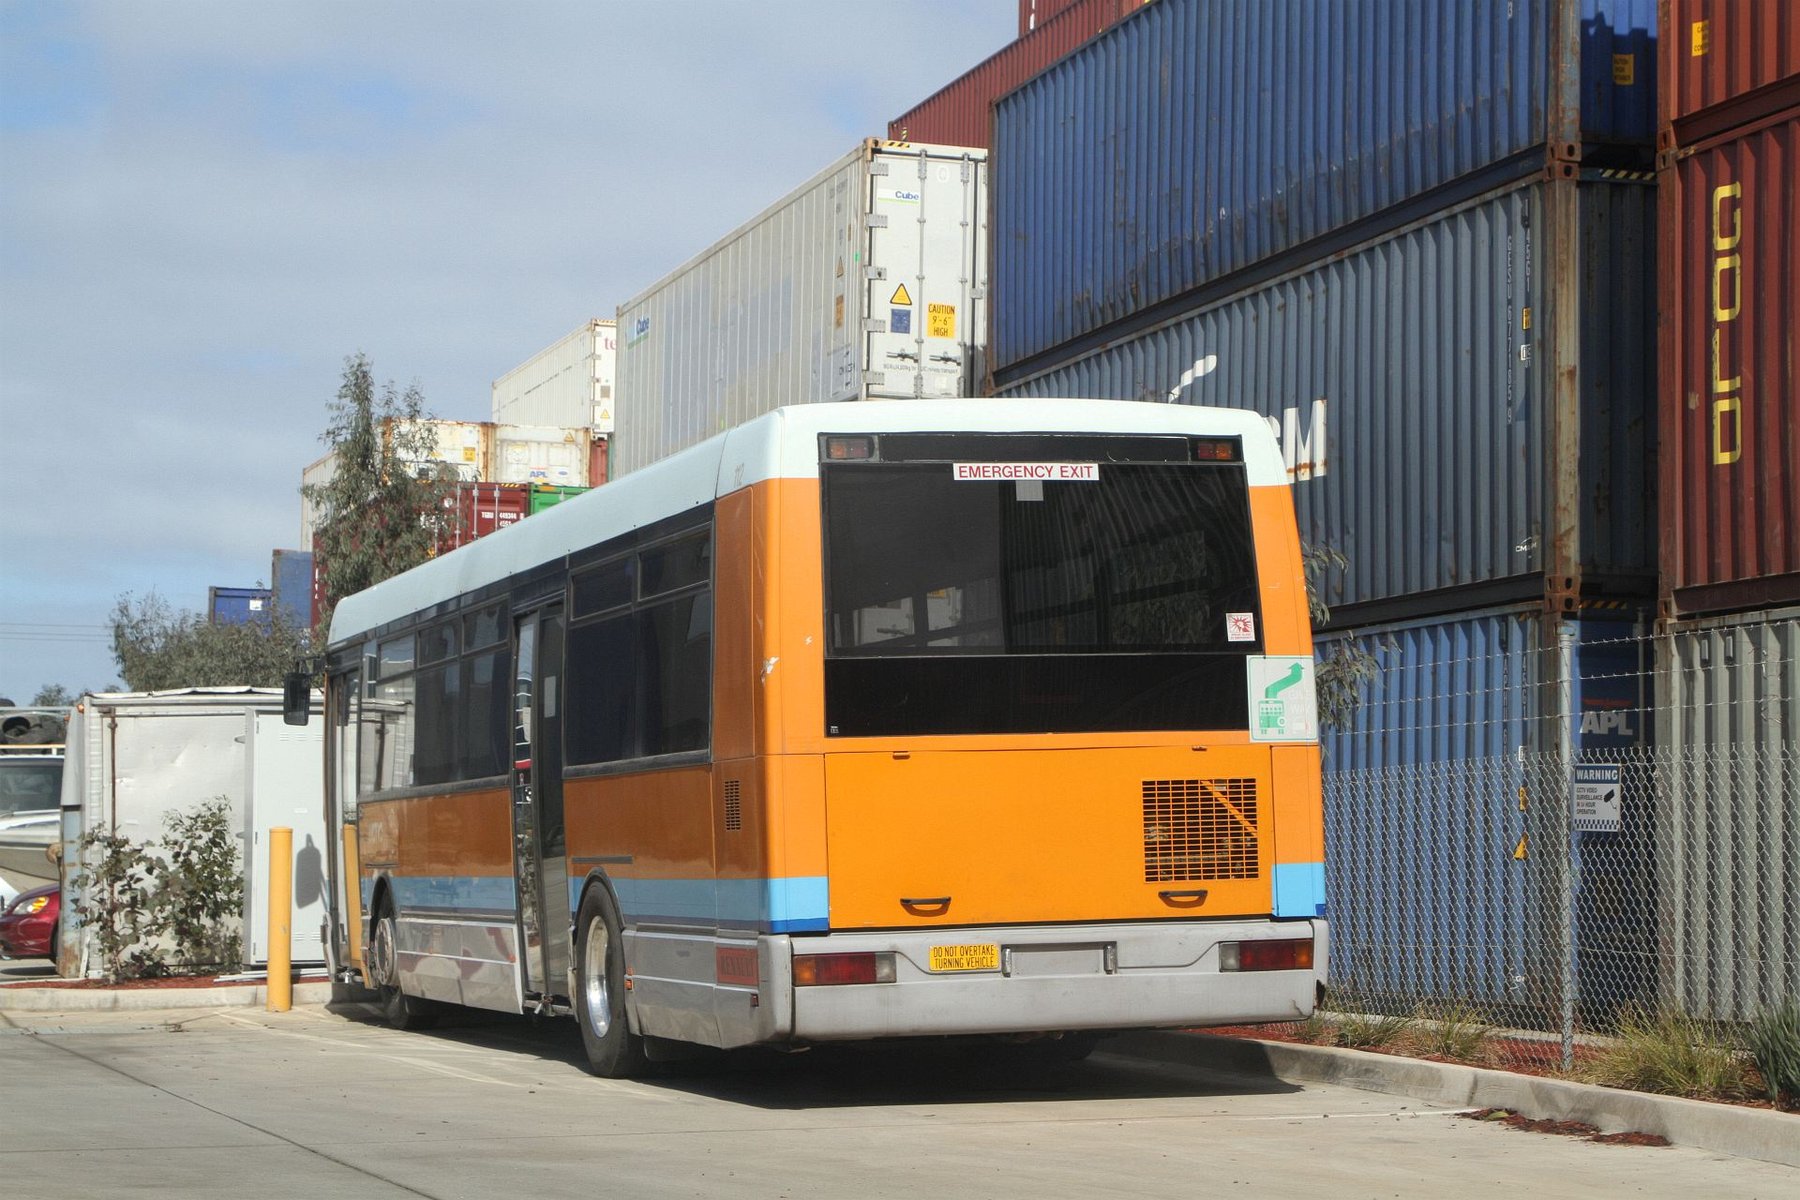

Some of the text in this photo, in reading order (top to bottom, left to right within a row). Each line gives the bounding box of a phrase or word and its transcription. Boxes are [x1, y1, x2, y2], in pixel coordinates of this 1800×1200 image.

[895, 190, 920, 201] Cube
[928, 303, 955, 316] CAUTION
[636, 316, 650, 335] Cube
[1713, 181, 1741, 465] GOLD
[933, 326, 949, 337] HIGH
[529, 470, 549, 479] APL
[958, 465, 1094, 479] EMERGENCY EXIT
[1579, 710, 1633, 736] APL
[1576, 769, 1618, 781] WARNING
[933, 944, 995, 958] DO NOT OVERTAKE
[934, 955, 995, 970] TURNING VEHICLE
